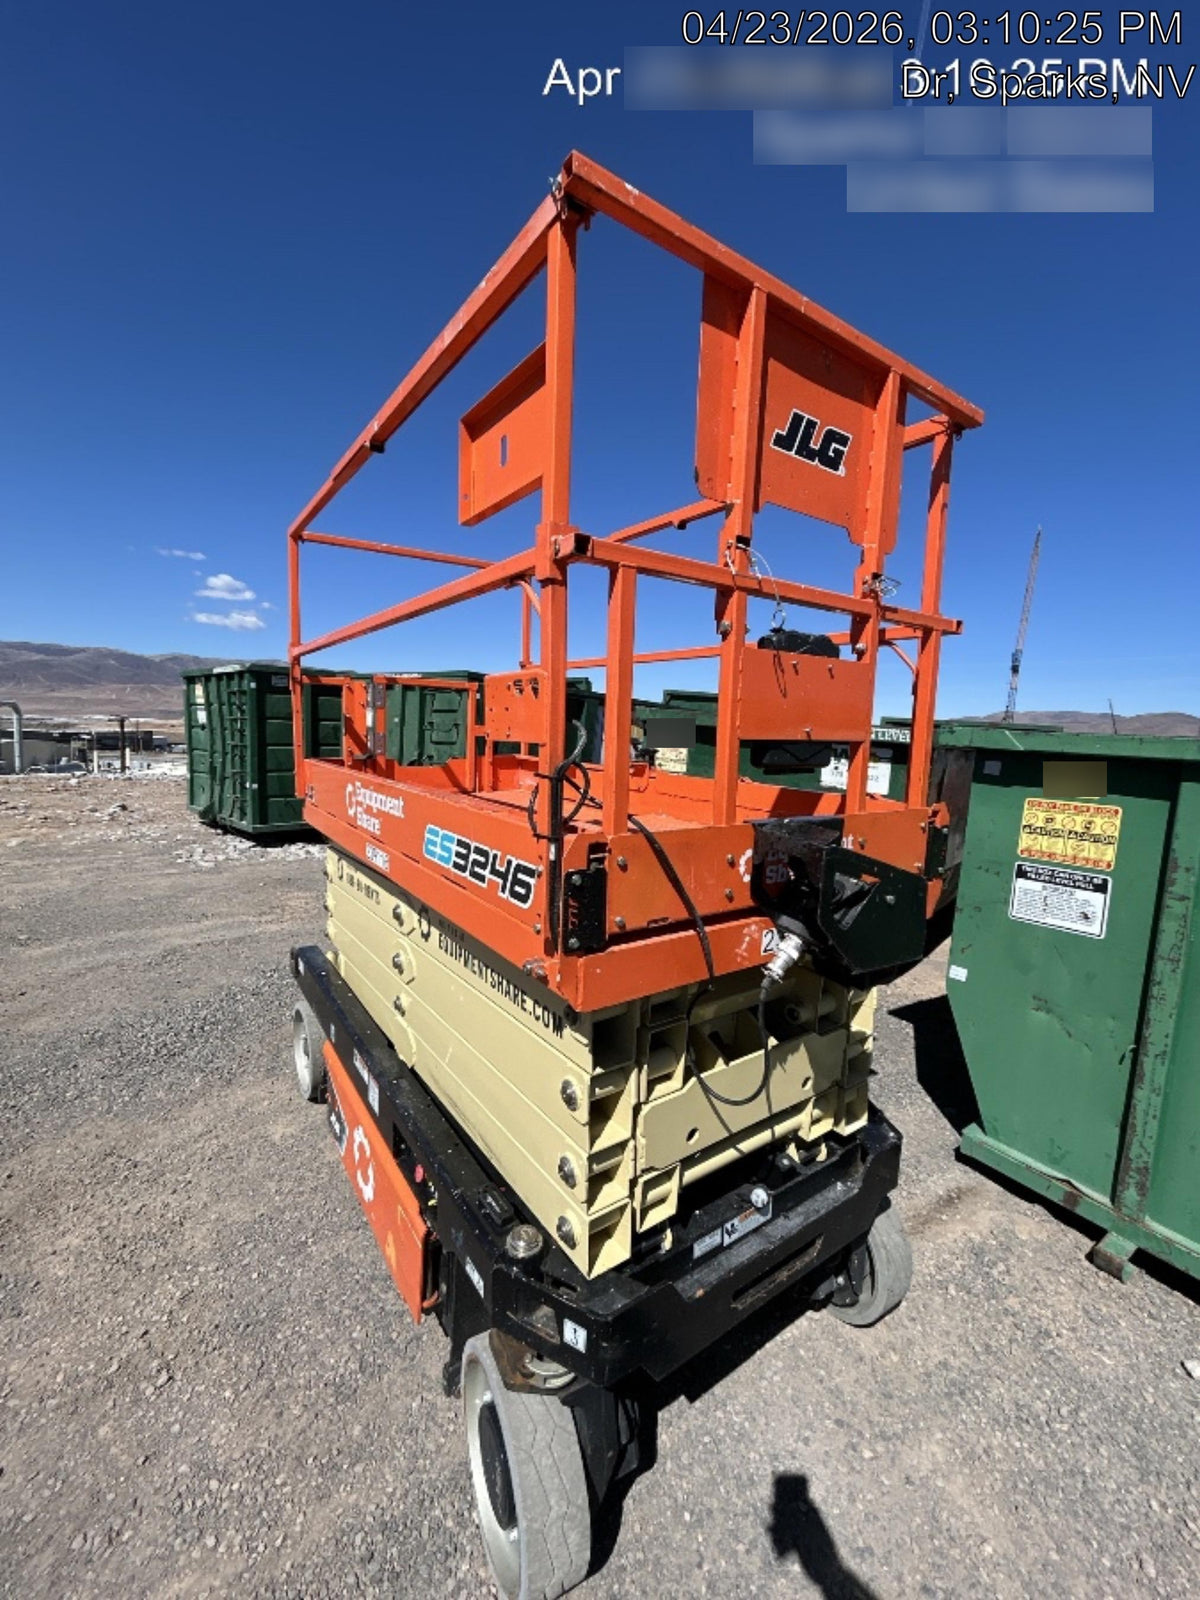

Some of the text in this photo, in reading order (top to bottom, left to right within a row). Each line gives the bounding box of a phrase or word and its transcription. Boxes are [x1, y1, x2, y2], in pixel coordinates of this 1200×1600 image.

[770, 408, 852, 477] JLG
[355, 781, 404, 818] Equipment
[357, 807, 381, 834] Share
[423, 824, 539, 909] ES3246
[438, 932, 563, 1039] EQUIPMENTSHARE.COM
